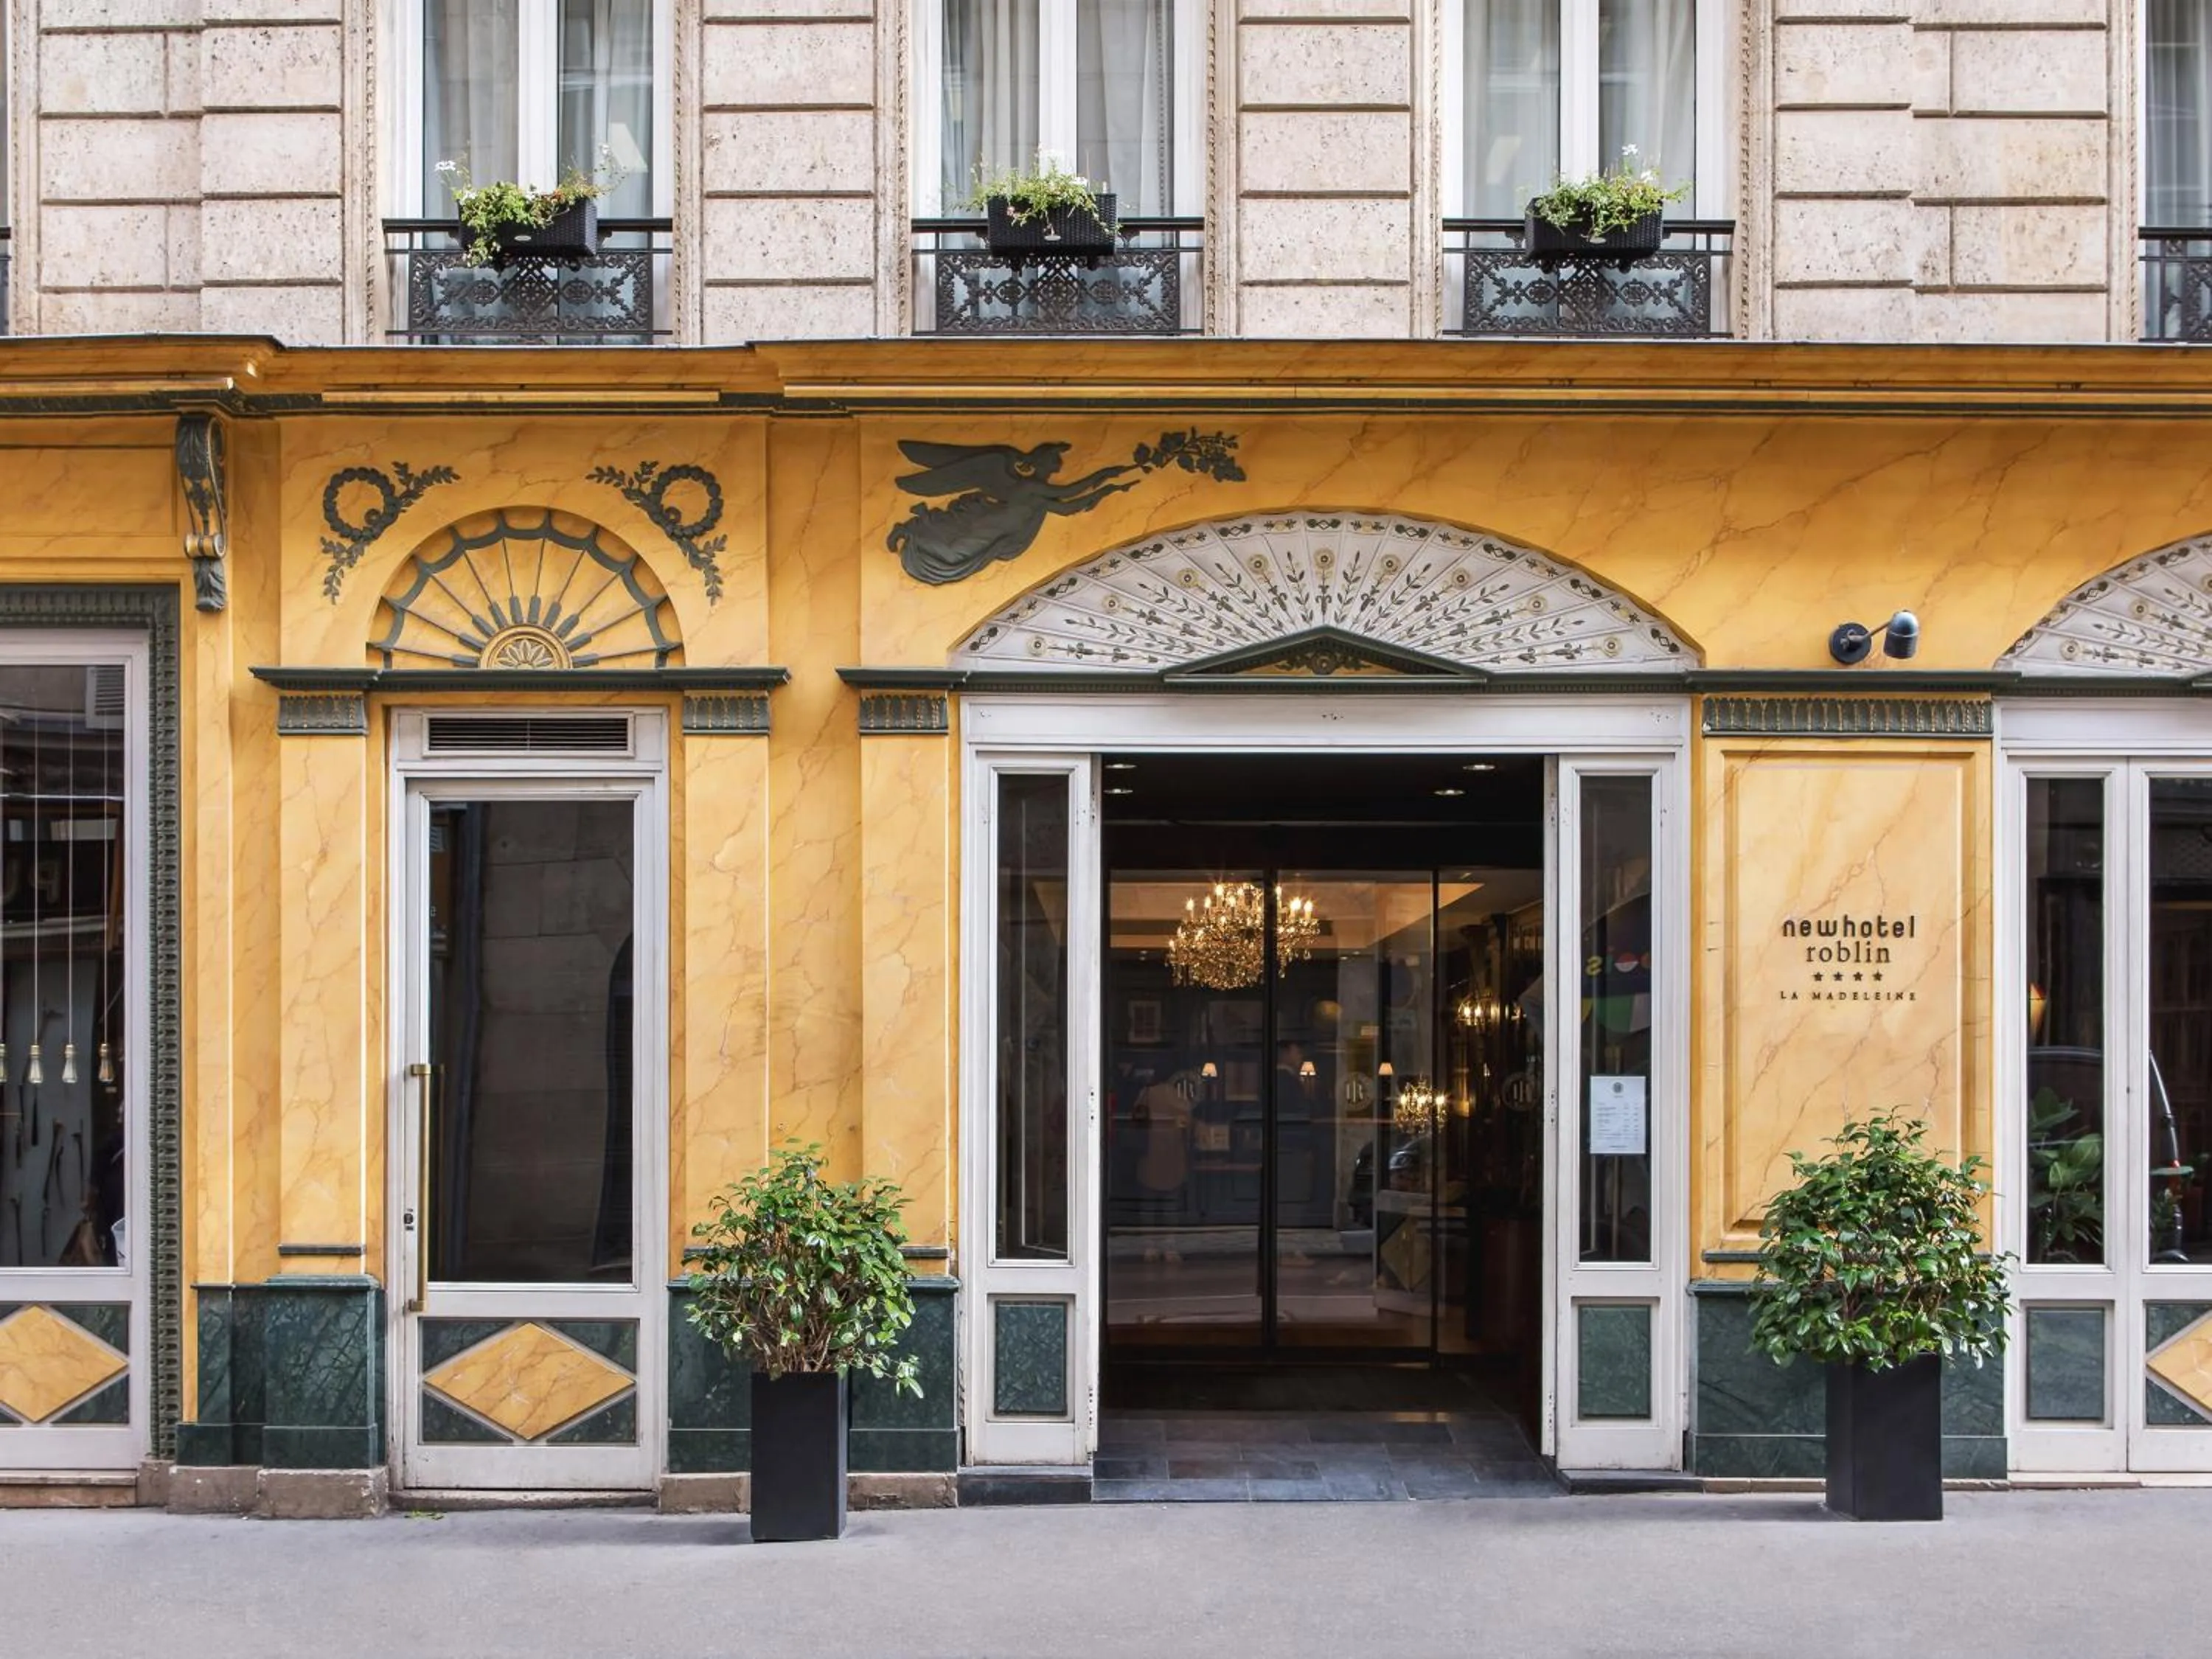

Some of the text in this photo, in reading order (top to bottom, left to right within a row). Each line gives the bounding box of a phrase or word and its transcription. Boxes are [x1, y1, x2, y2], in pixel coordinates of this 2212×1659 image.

[1782, 914, 1916, 939] newhotel
[1806, 940, 1891, 964] roblin
[1781, 990, 1916, 1001] LA MADELEINE
